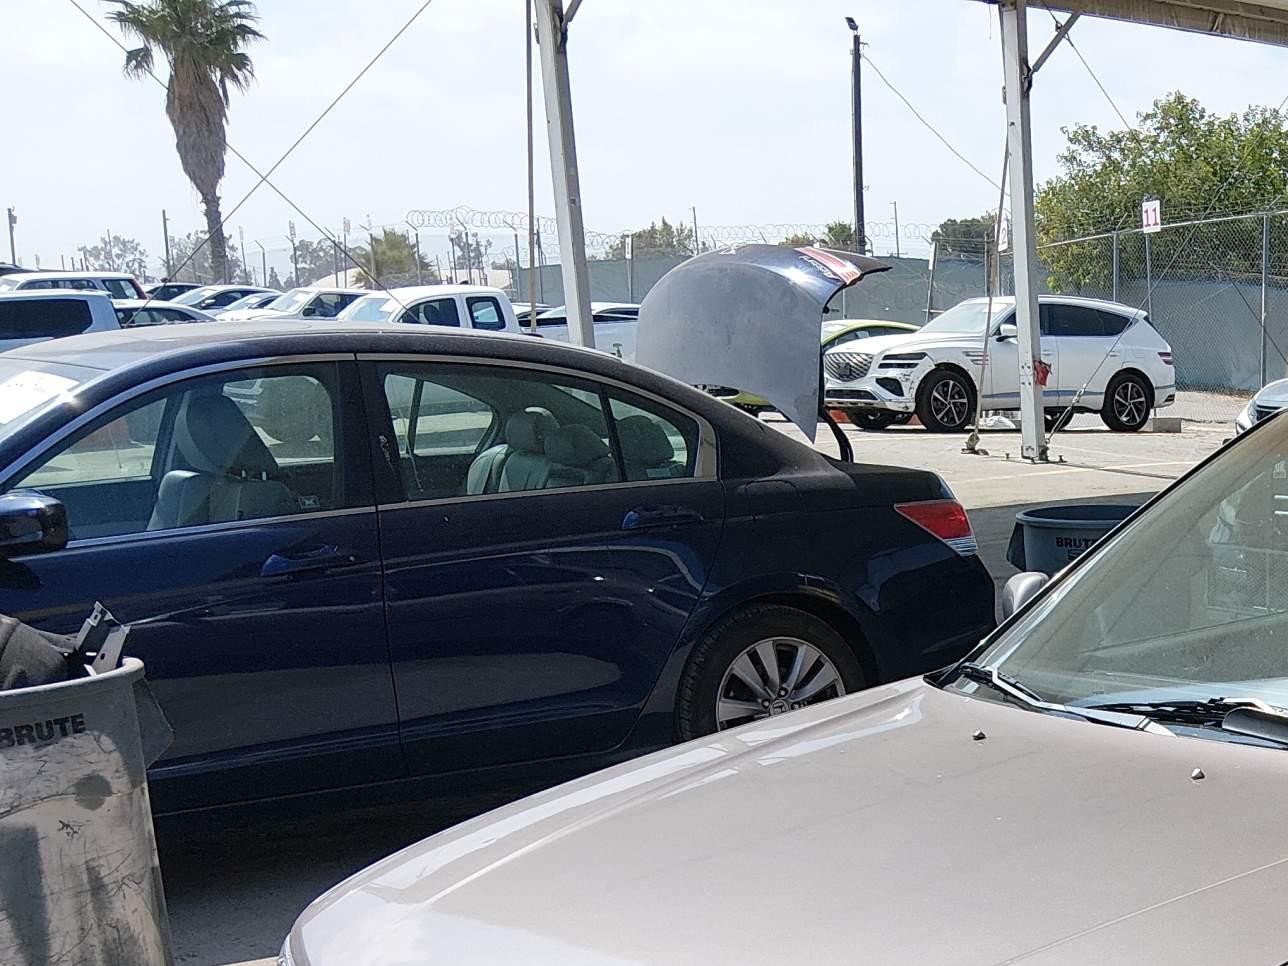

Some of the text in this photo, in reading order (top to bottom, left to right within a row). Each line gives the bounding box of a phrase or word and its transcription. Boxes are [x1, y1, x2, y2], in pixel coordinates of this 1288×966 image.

[1144, 208, 1159, 227] 11
[1056, 537, 1101, 548] BRUT
[0, 713, 87, 749] BRUTE
